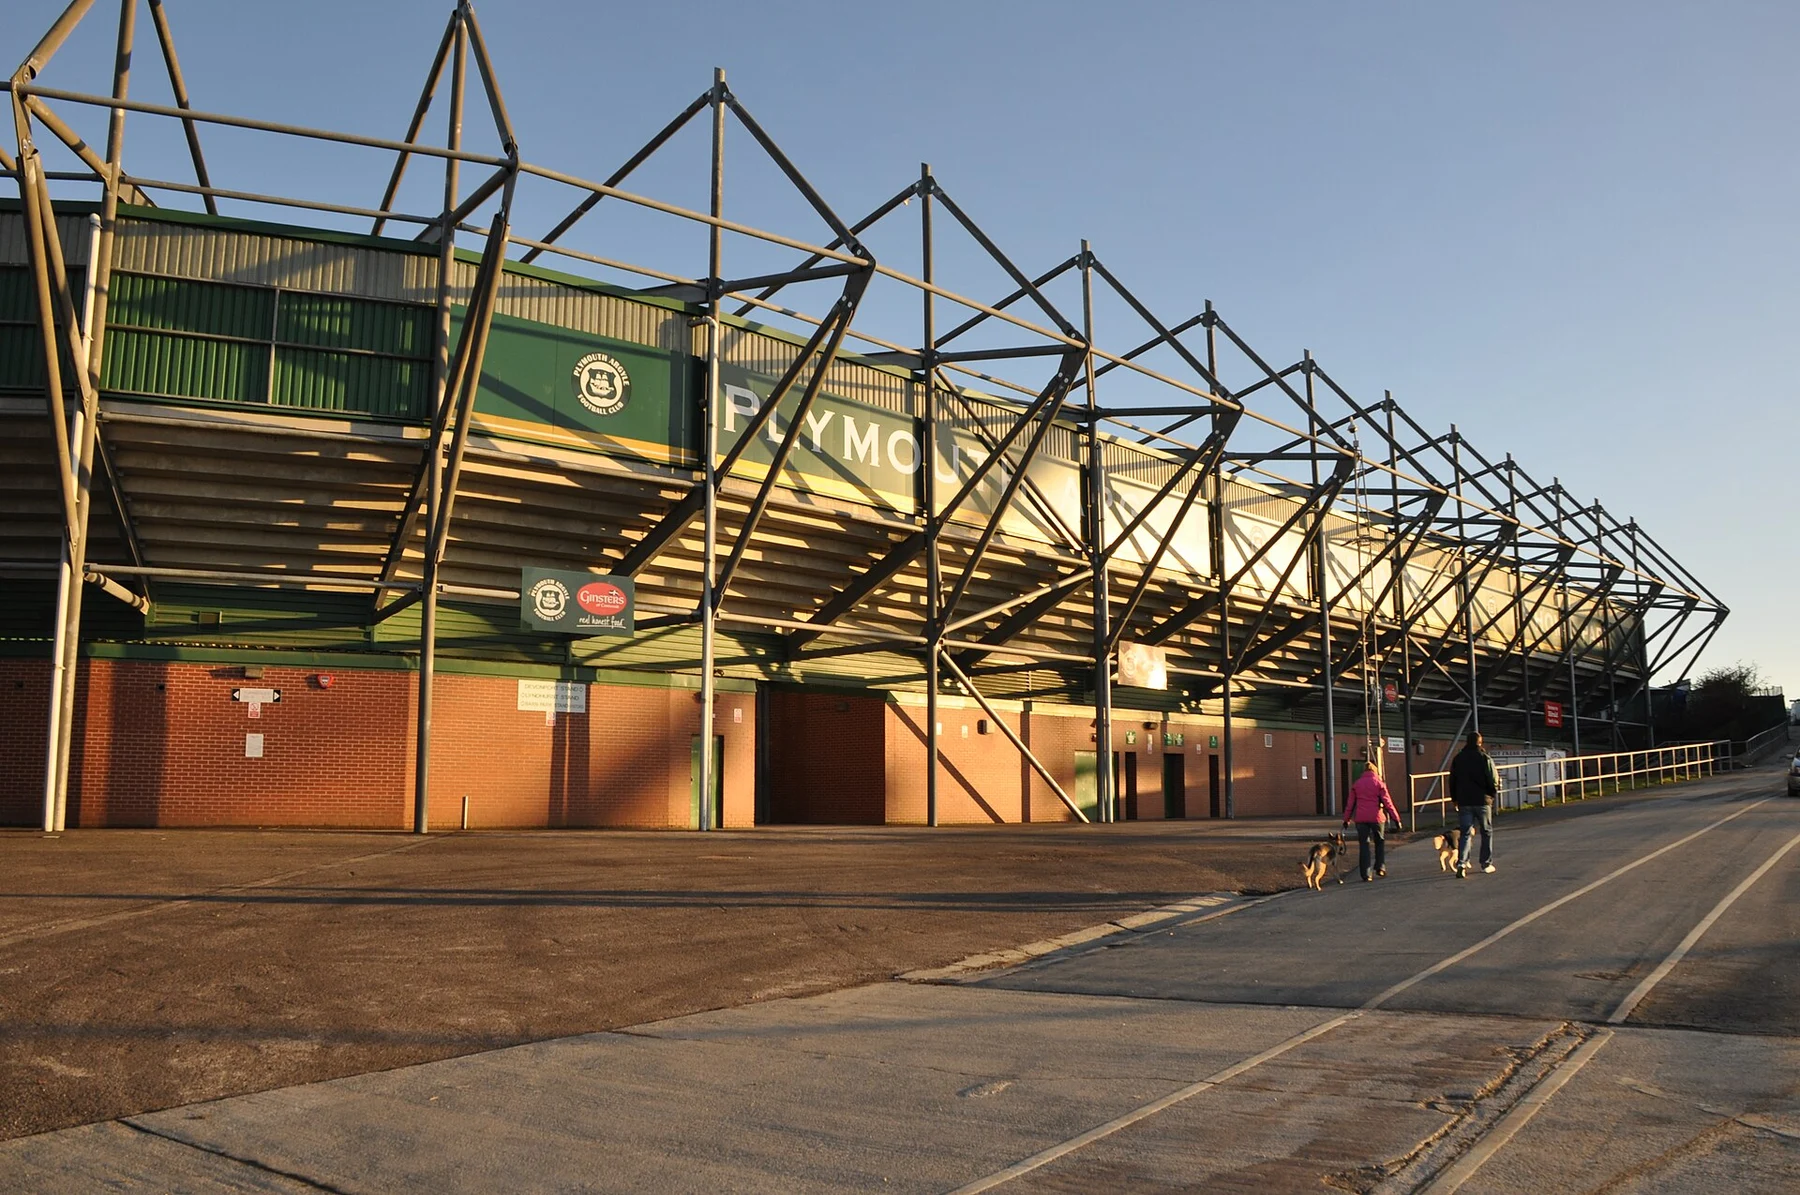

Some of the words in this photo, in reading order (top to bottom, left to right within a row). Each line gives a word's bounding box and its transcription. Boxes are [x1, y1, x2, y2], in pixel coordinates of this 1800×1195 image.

[573, 353, 608, 377] PLYMOUTH
[608, 358, 630, 386] ARGYLE
[577, 393, 608, 415] FOOTBALL
[608, 401, 624, 414] CLUB
